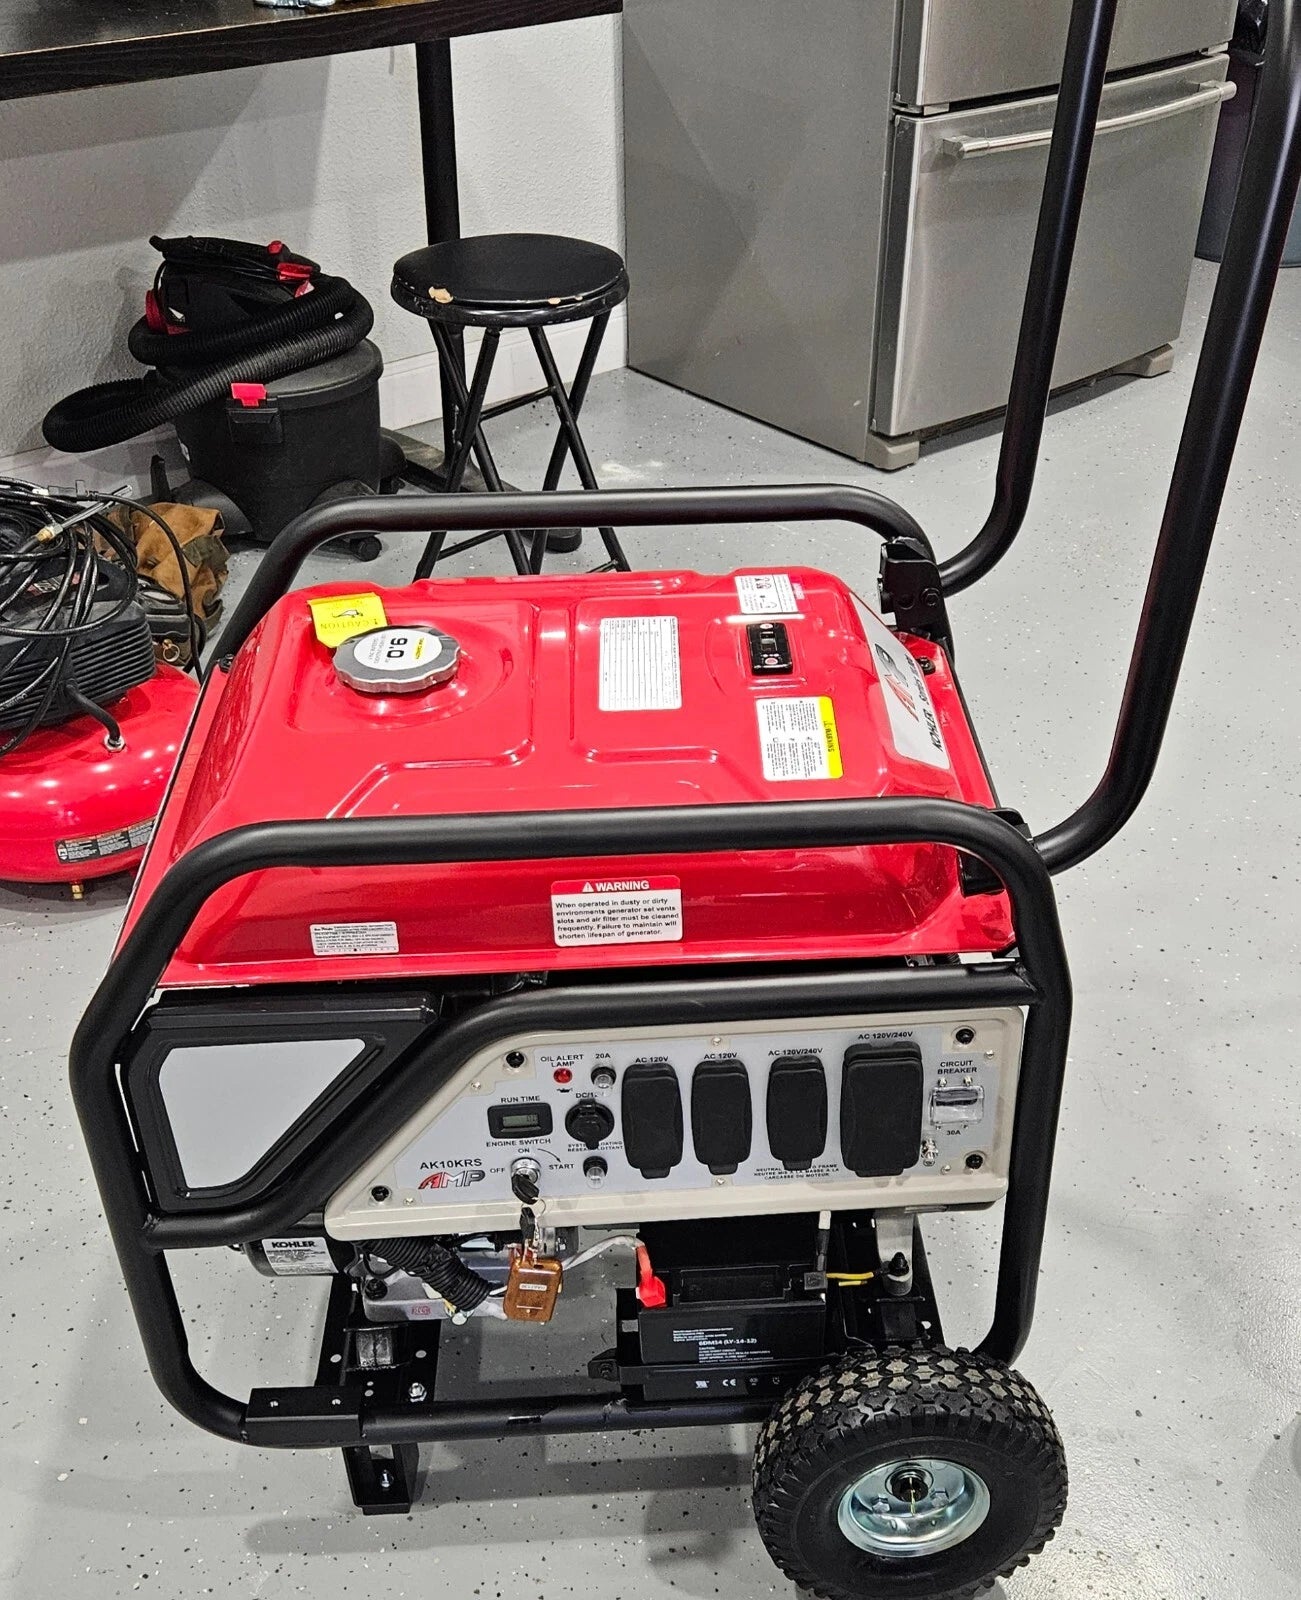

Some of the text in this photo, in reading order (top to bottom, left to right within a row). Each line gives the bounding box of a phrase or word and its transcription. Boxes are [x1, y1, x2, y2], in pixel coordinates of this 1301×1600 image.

[387, 638, 408, 658] 9.0
[923, 708, 943, 752] KOHLER
[595, 880, 650, 892] WARNING
[607, 906, 641, 915] generator
[557, 924, 596, 932] frequently.
[626, 929, 663, 937] generator.
[873, 1031, 913, 1040] 120V/240V
[783, 1047, 823, 1056] 120V/240V
[556, 1053, 584, 1061] ALERT
[937, 1067, 977, 1075] BREAKER
[519, 1138, 551, 1146] SWITCH
[420, 1158, 483, 1170] AK10KRS
[418, 1170, 486, 1189] AMP
[271, 1240, 317, 1249] KOHLER
